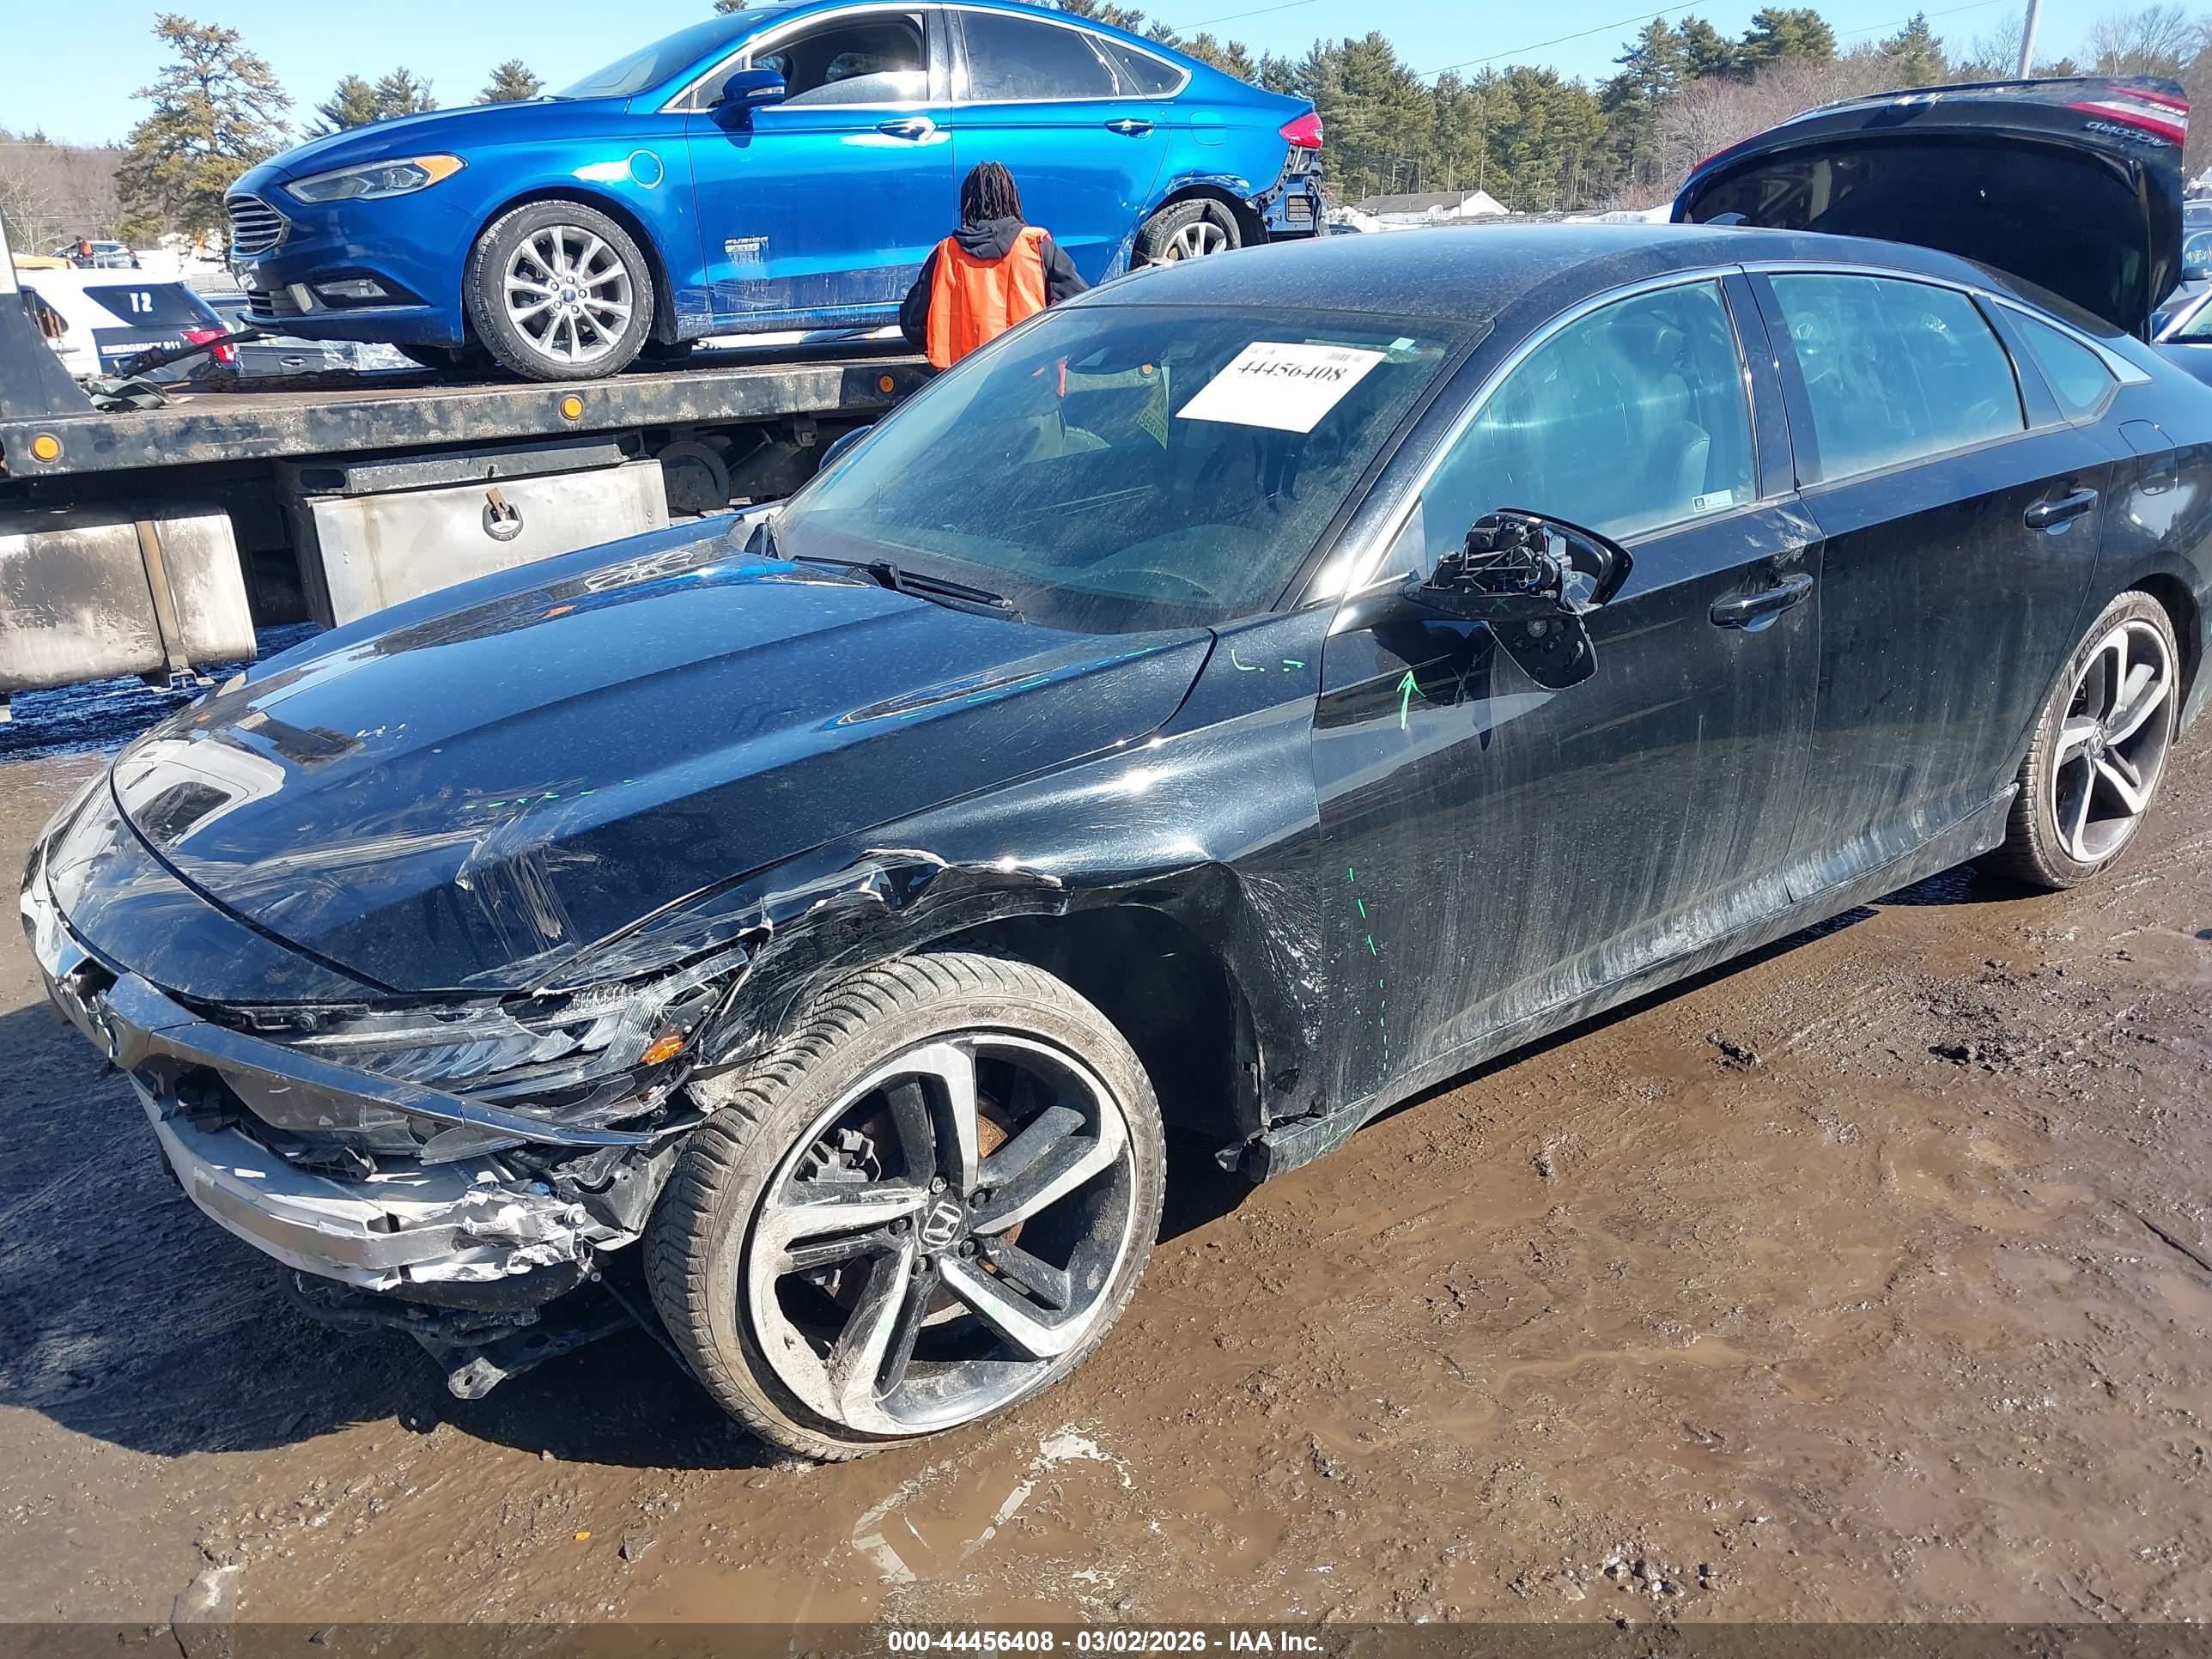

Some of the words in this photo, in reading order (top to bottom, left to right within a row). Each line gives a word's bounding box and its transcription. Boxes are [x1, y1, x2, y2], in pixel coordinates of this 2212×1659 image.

[2084, 122, 2172, 149] ACCORD
[100, 342, 161, 355] EMERGENCY
[163, 341, 182, 350] 911
[1237, 361, 1348, 382] 44456408
[2080, 611, 2121, 660] GOODYEAR
